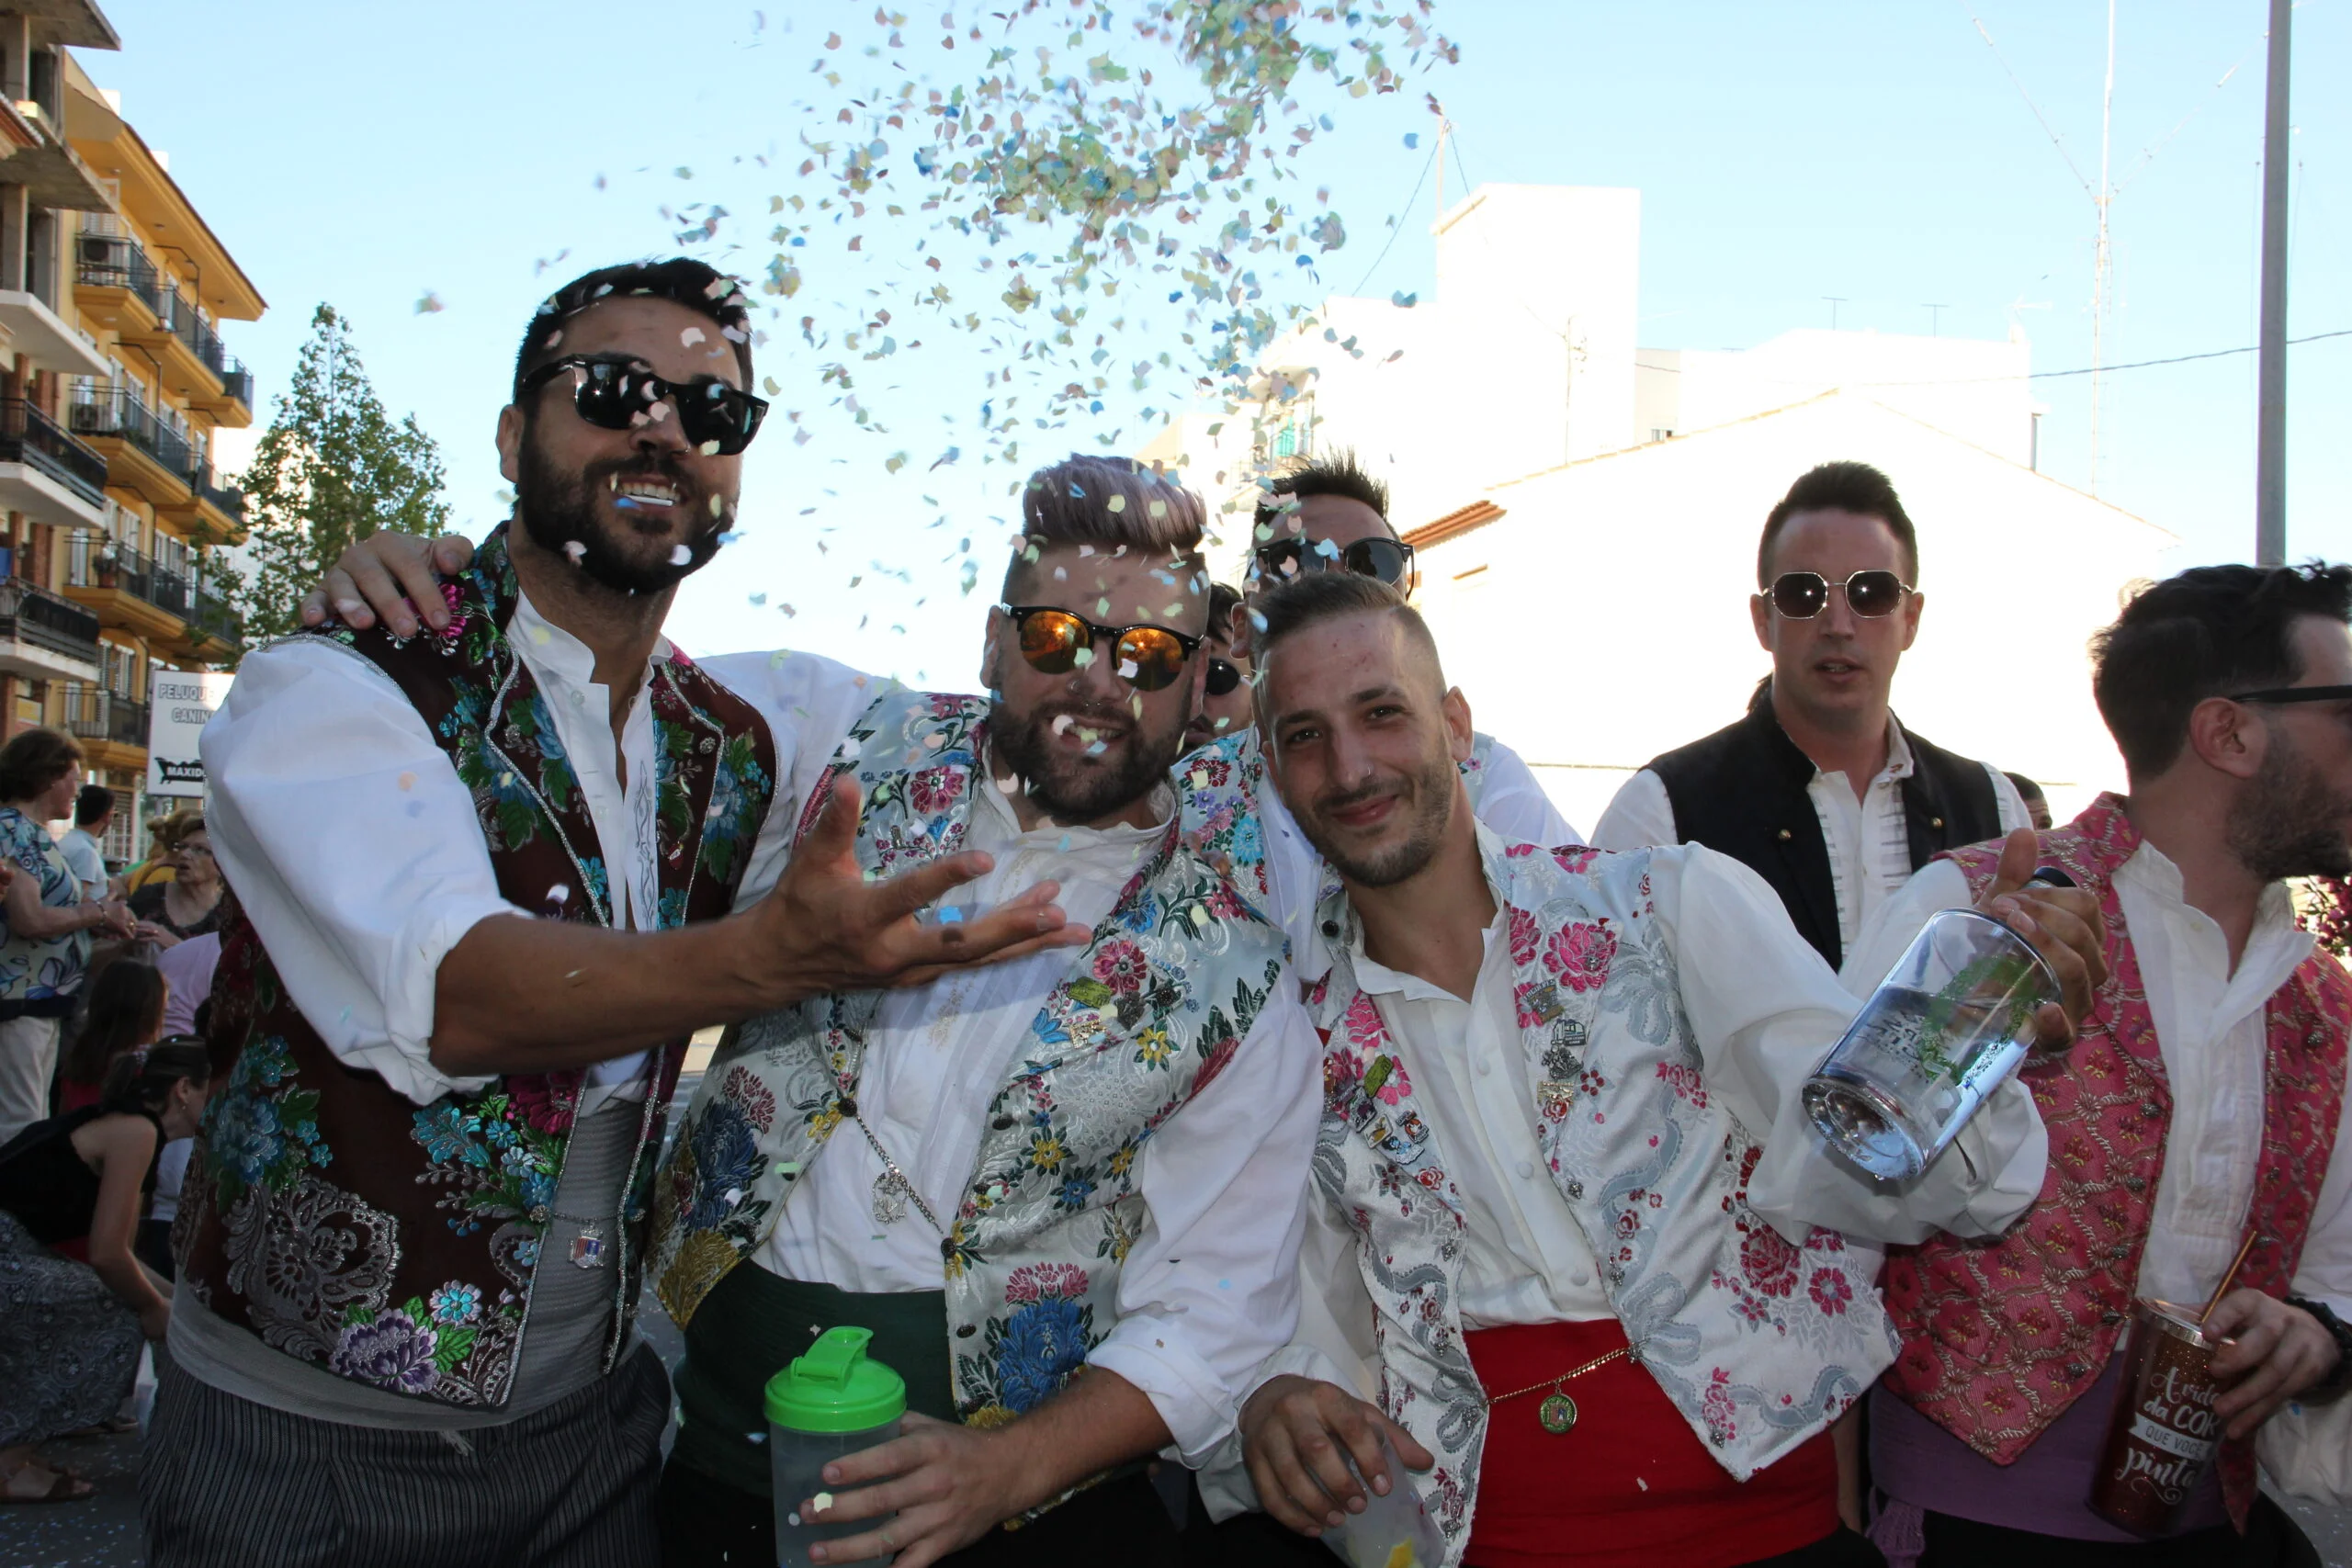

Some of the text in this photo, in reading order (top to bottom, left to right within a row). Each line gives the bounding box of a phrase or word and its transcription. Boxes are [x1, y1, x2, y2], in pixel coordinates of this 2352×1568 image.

[159, 683, 216, 702] PELUQUE
[2143, 1395, 2169, 1422] da
[2145, 1425, 2171, 1446] QUE
[2115, 1447, 2198, 1486] pinta
